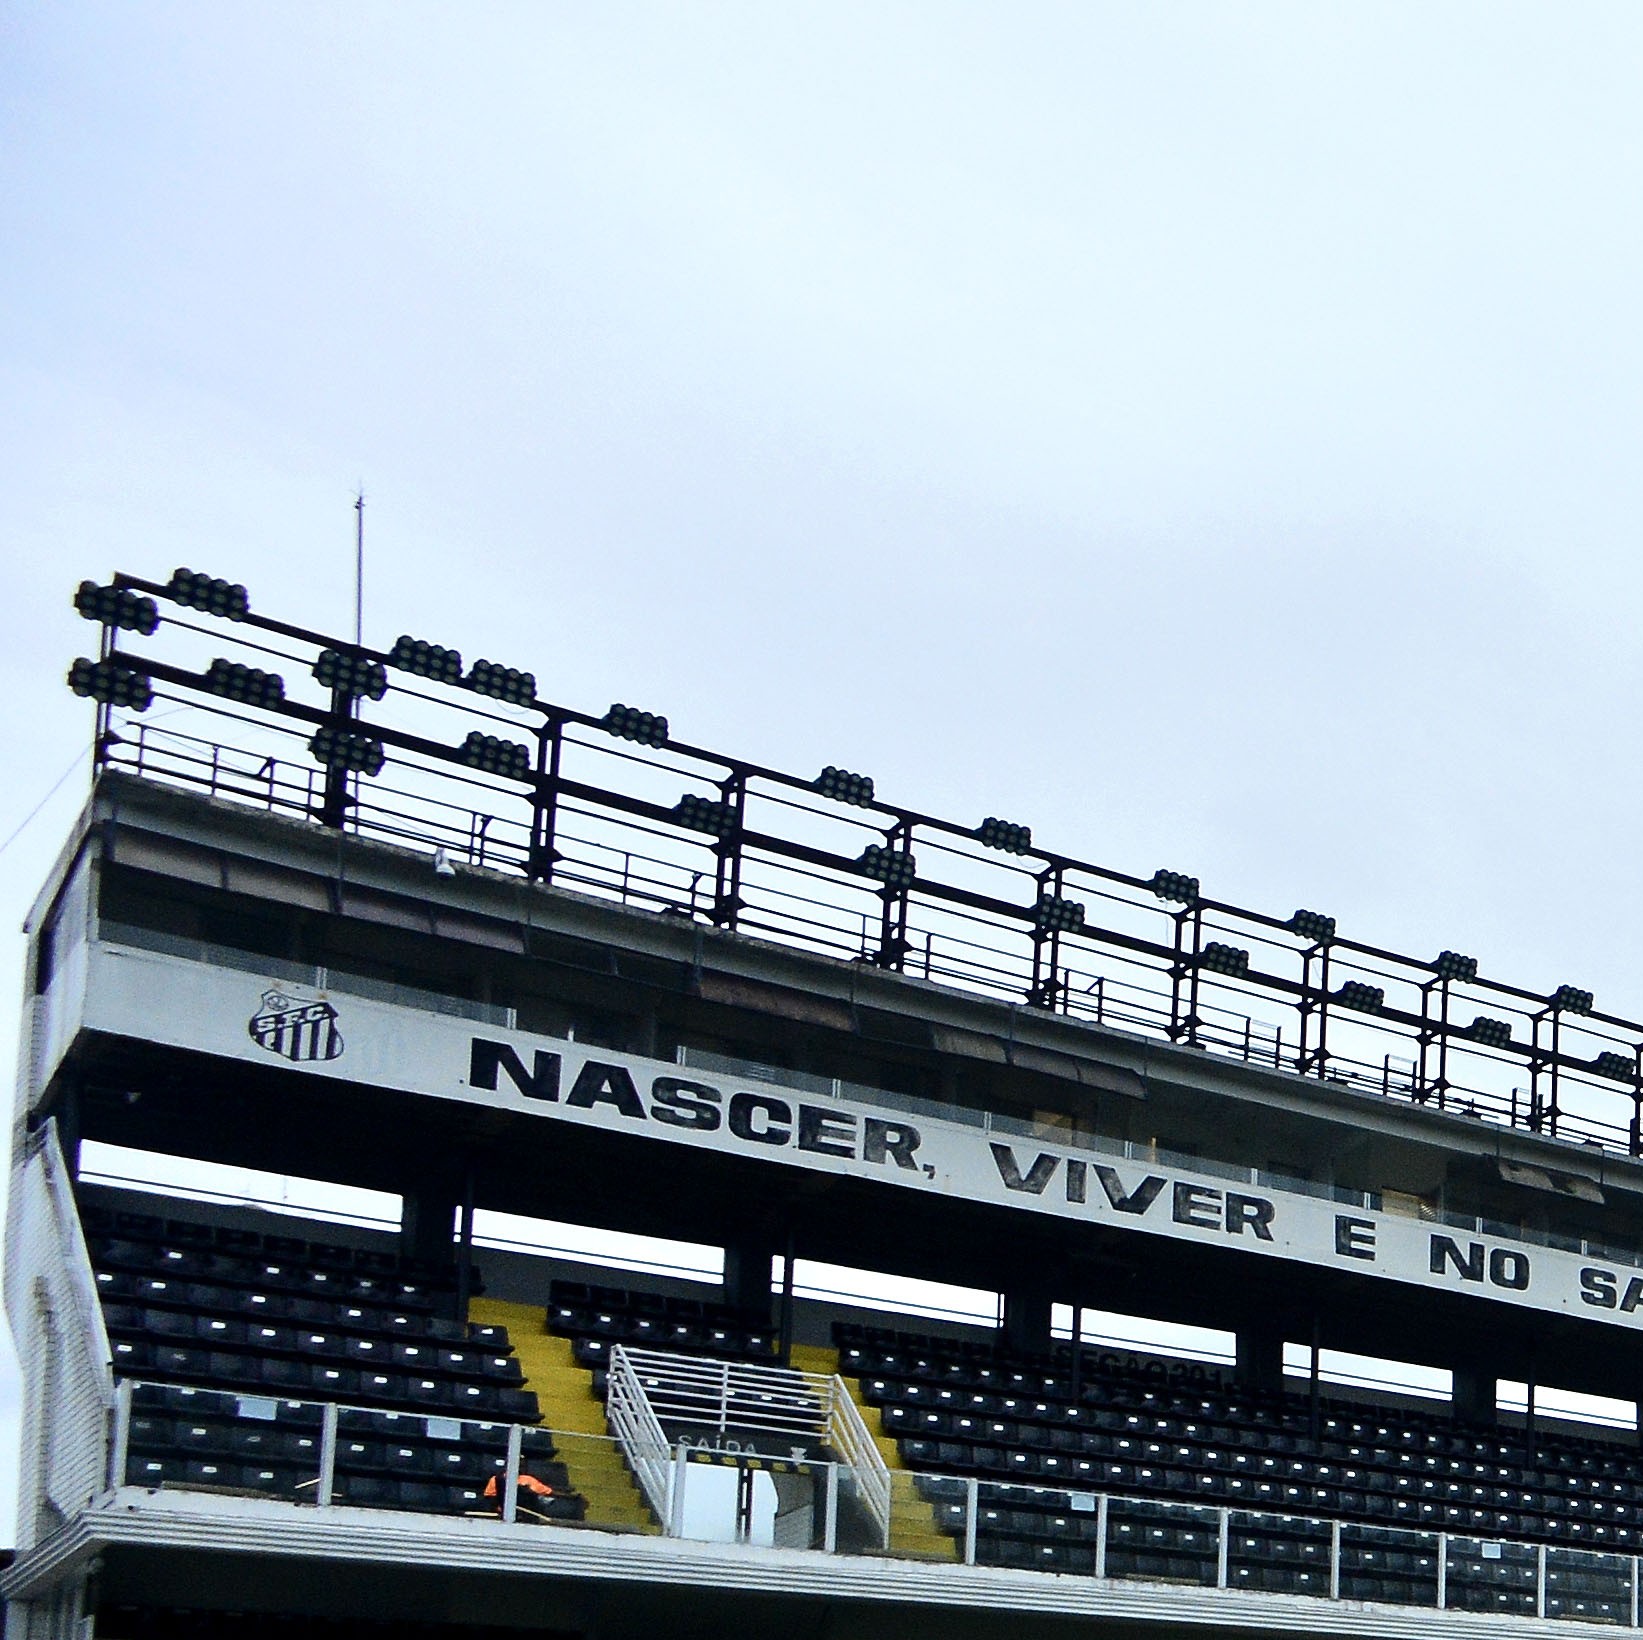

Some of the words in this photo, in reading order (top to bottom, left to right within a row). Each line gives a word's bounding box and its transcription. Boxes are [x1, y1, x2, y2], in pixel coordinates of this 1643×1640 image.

[468, 1036, 936, 1180] NASCER,
[988, 1141, 1276, 1242] VIVER
[1334, 1214, 1377, 1262] E
[1429, 1233, 1531, 1291] NO
